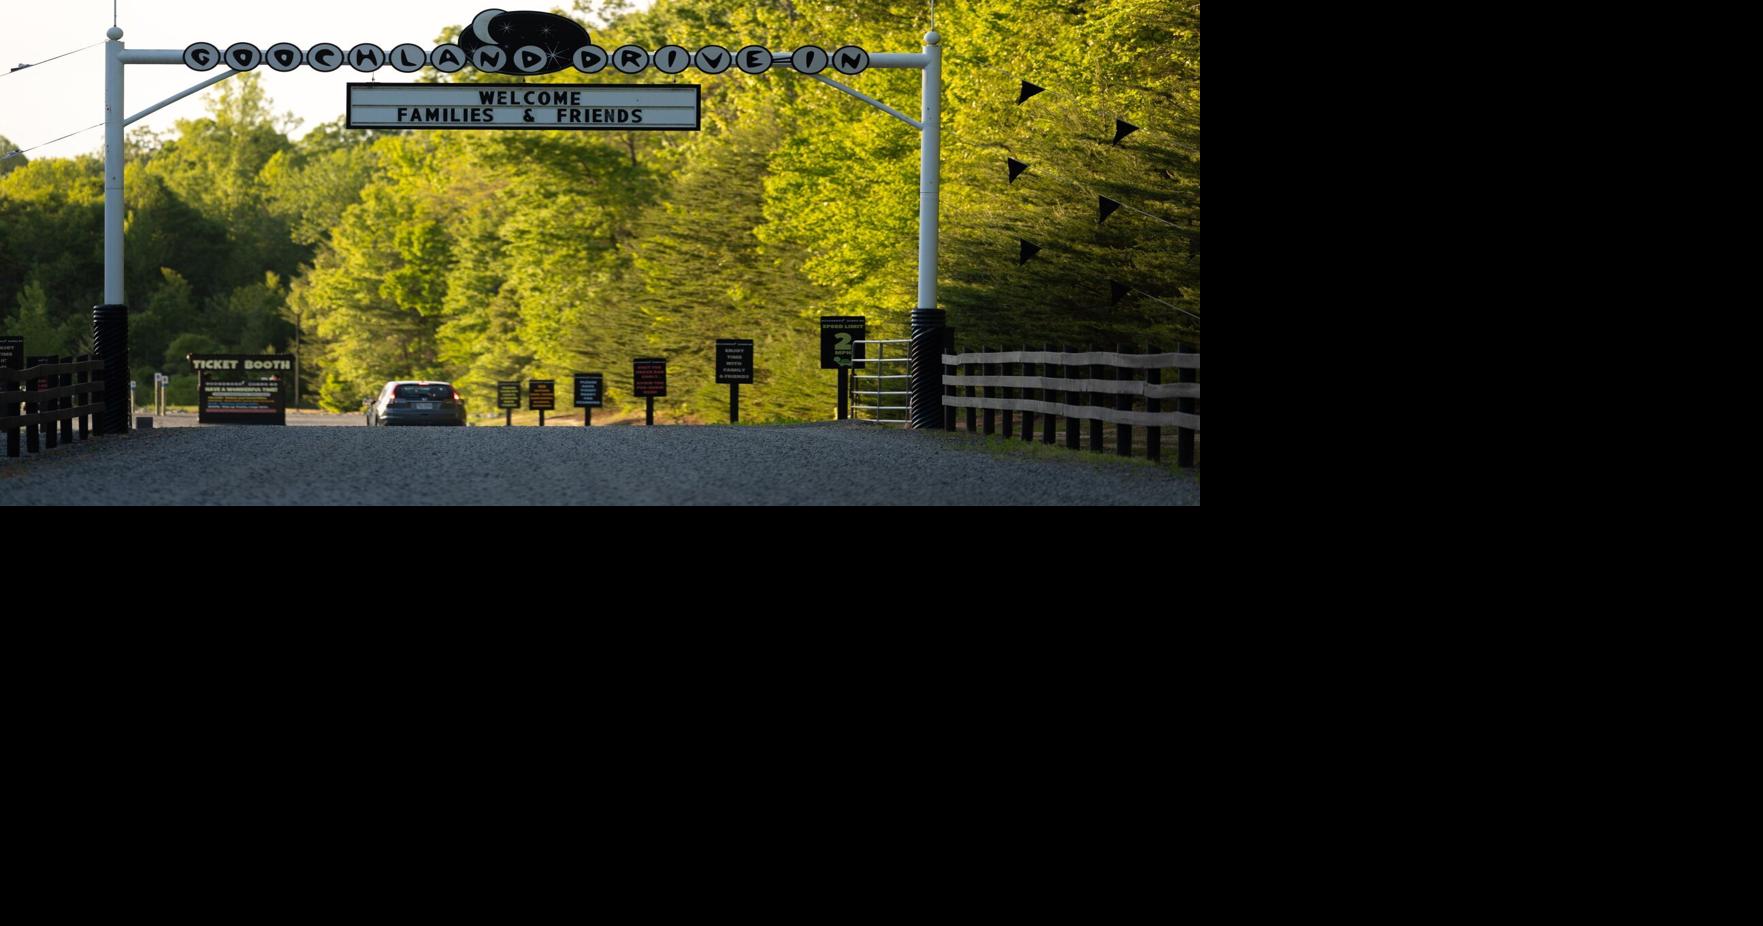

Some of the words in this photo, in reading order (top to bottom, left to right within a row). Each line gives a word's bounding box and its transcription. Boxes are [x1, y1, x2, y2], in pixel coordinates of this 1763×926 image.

[189, 46, 546, 69] GOOCHLAND
[478, 91, 582, 106] WELCOME
[396, 107, 494, 123] FAMILIES
[523, 108, 536, 123] &
[556, 108, 643, 124] FRIENDS
[834, 332, 852, 350] 2
[192, 360, 239, 369] TICKET
[244, 360, 290, 369] BOOTH
